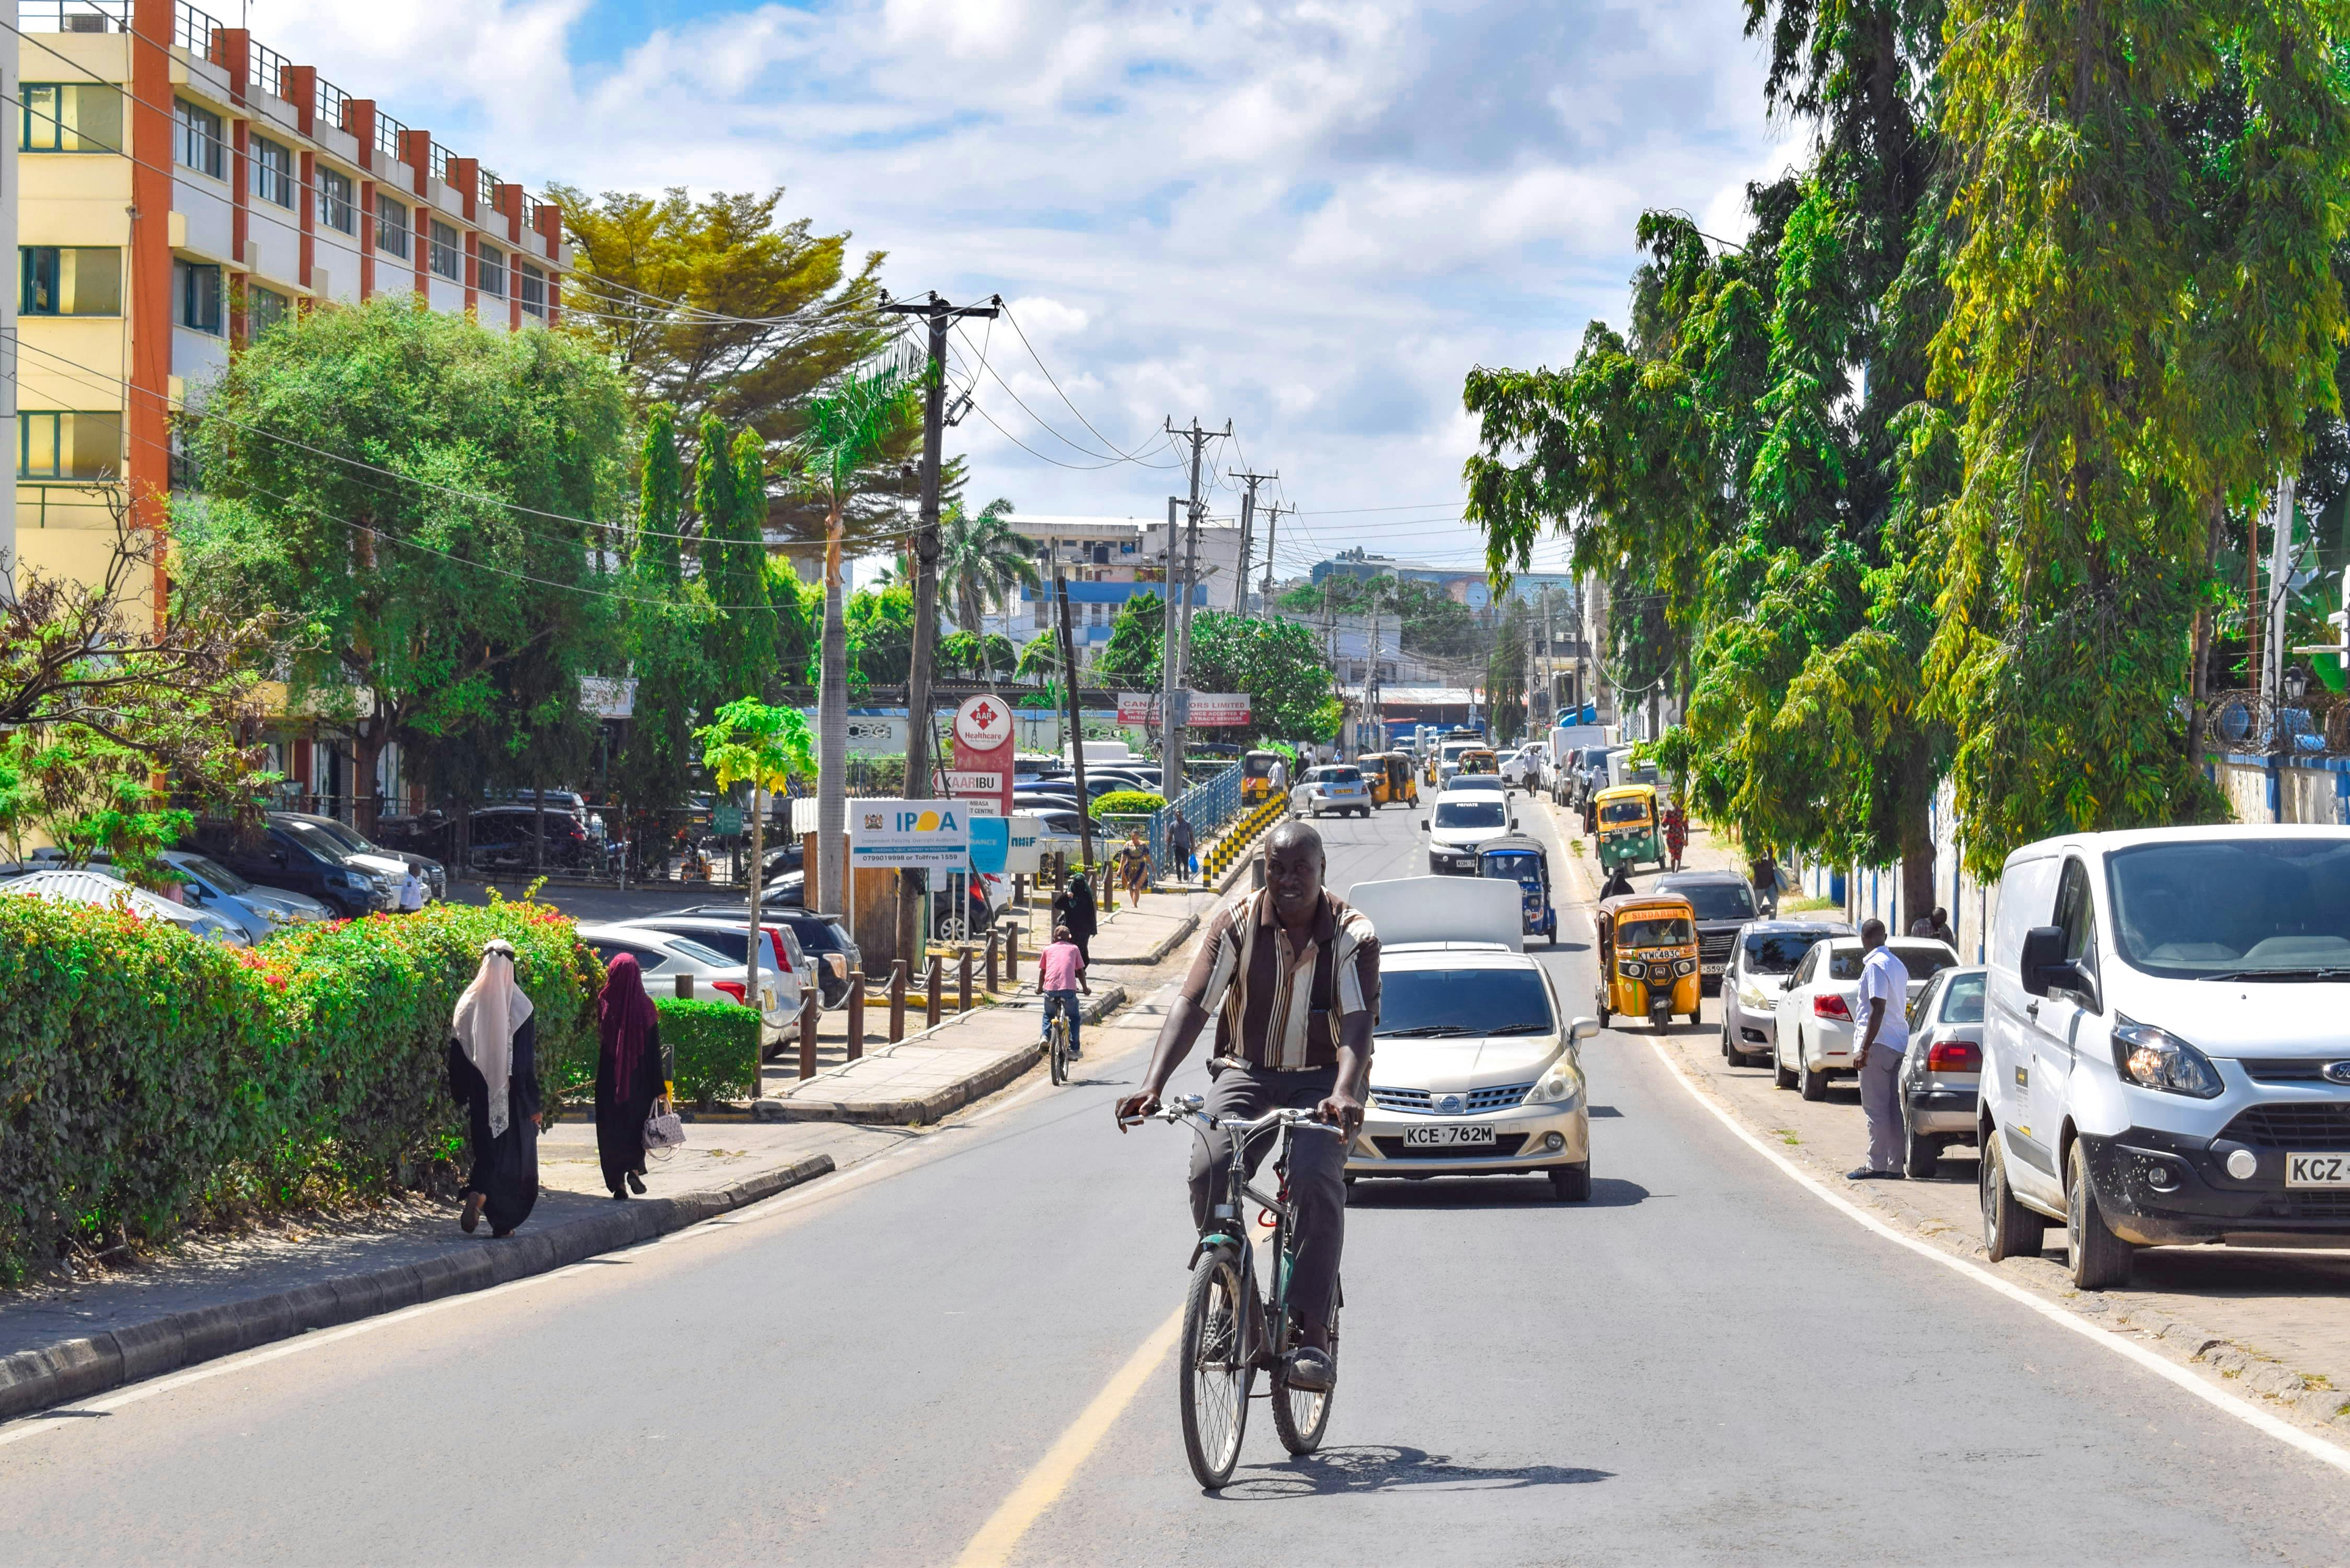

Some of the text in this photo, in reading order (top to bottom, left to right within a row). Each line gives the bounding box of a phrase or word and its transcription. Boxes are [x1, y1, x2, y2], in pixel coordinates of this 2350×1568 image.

[896, 811, 958, 832] IPOA
[1408, 1127, 1492, 1144] KCE 762M
[2293, 1158, 2342, 1181] KCZ
